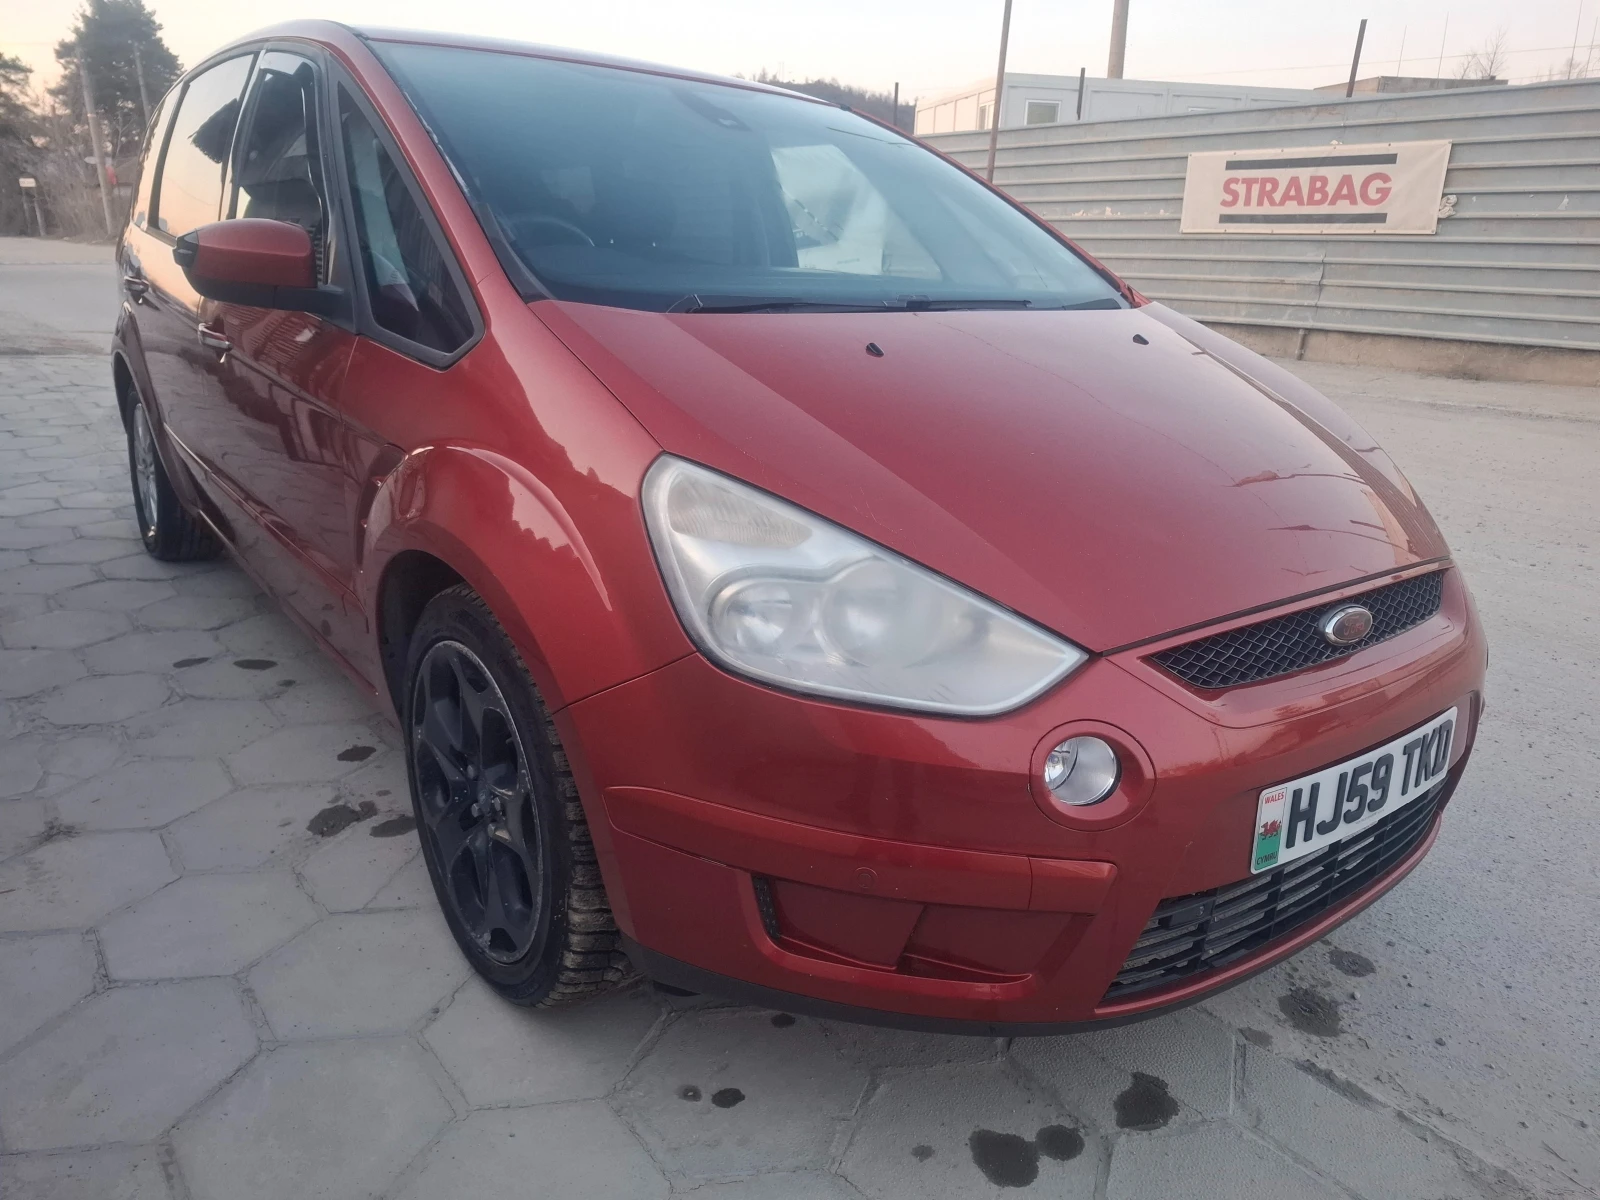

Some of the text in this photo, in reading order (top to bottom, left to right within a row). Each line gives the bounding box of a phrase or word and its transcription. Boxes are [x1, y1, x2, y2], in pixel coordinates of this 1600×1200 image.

[1220, 172, 1392, 208] STRABAG
[1285, 719, 1453, 849] HJ59 TKD
[1264, 791, 1285, 804] WALES
[1256, 851, 1279, 866] CYMRU
